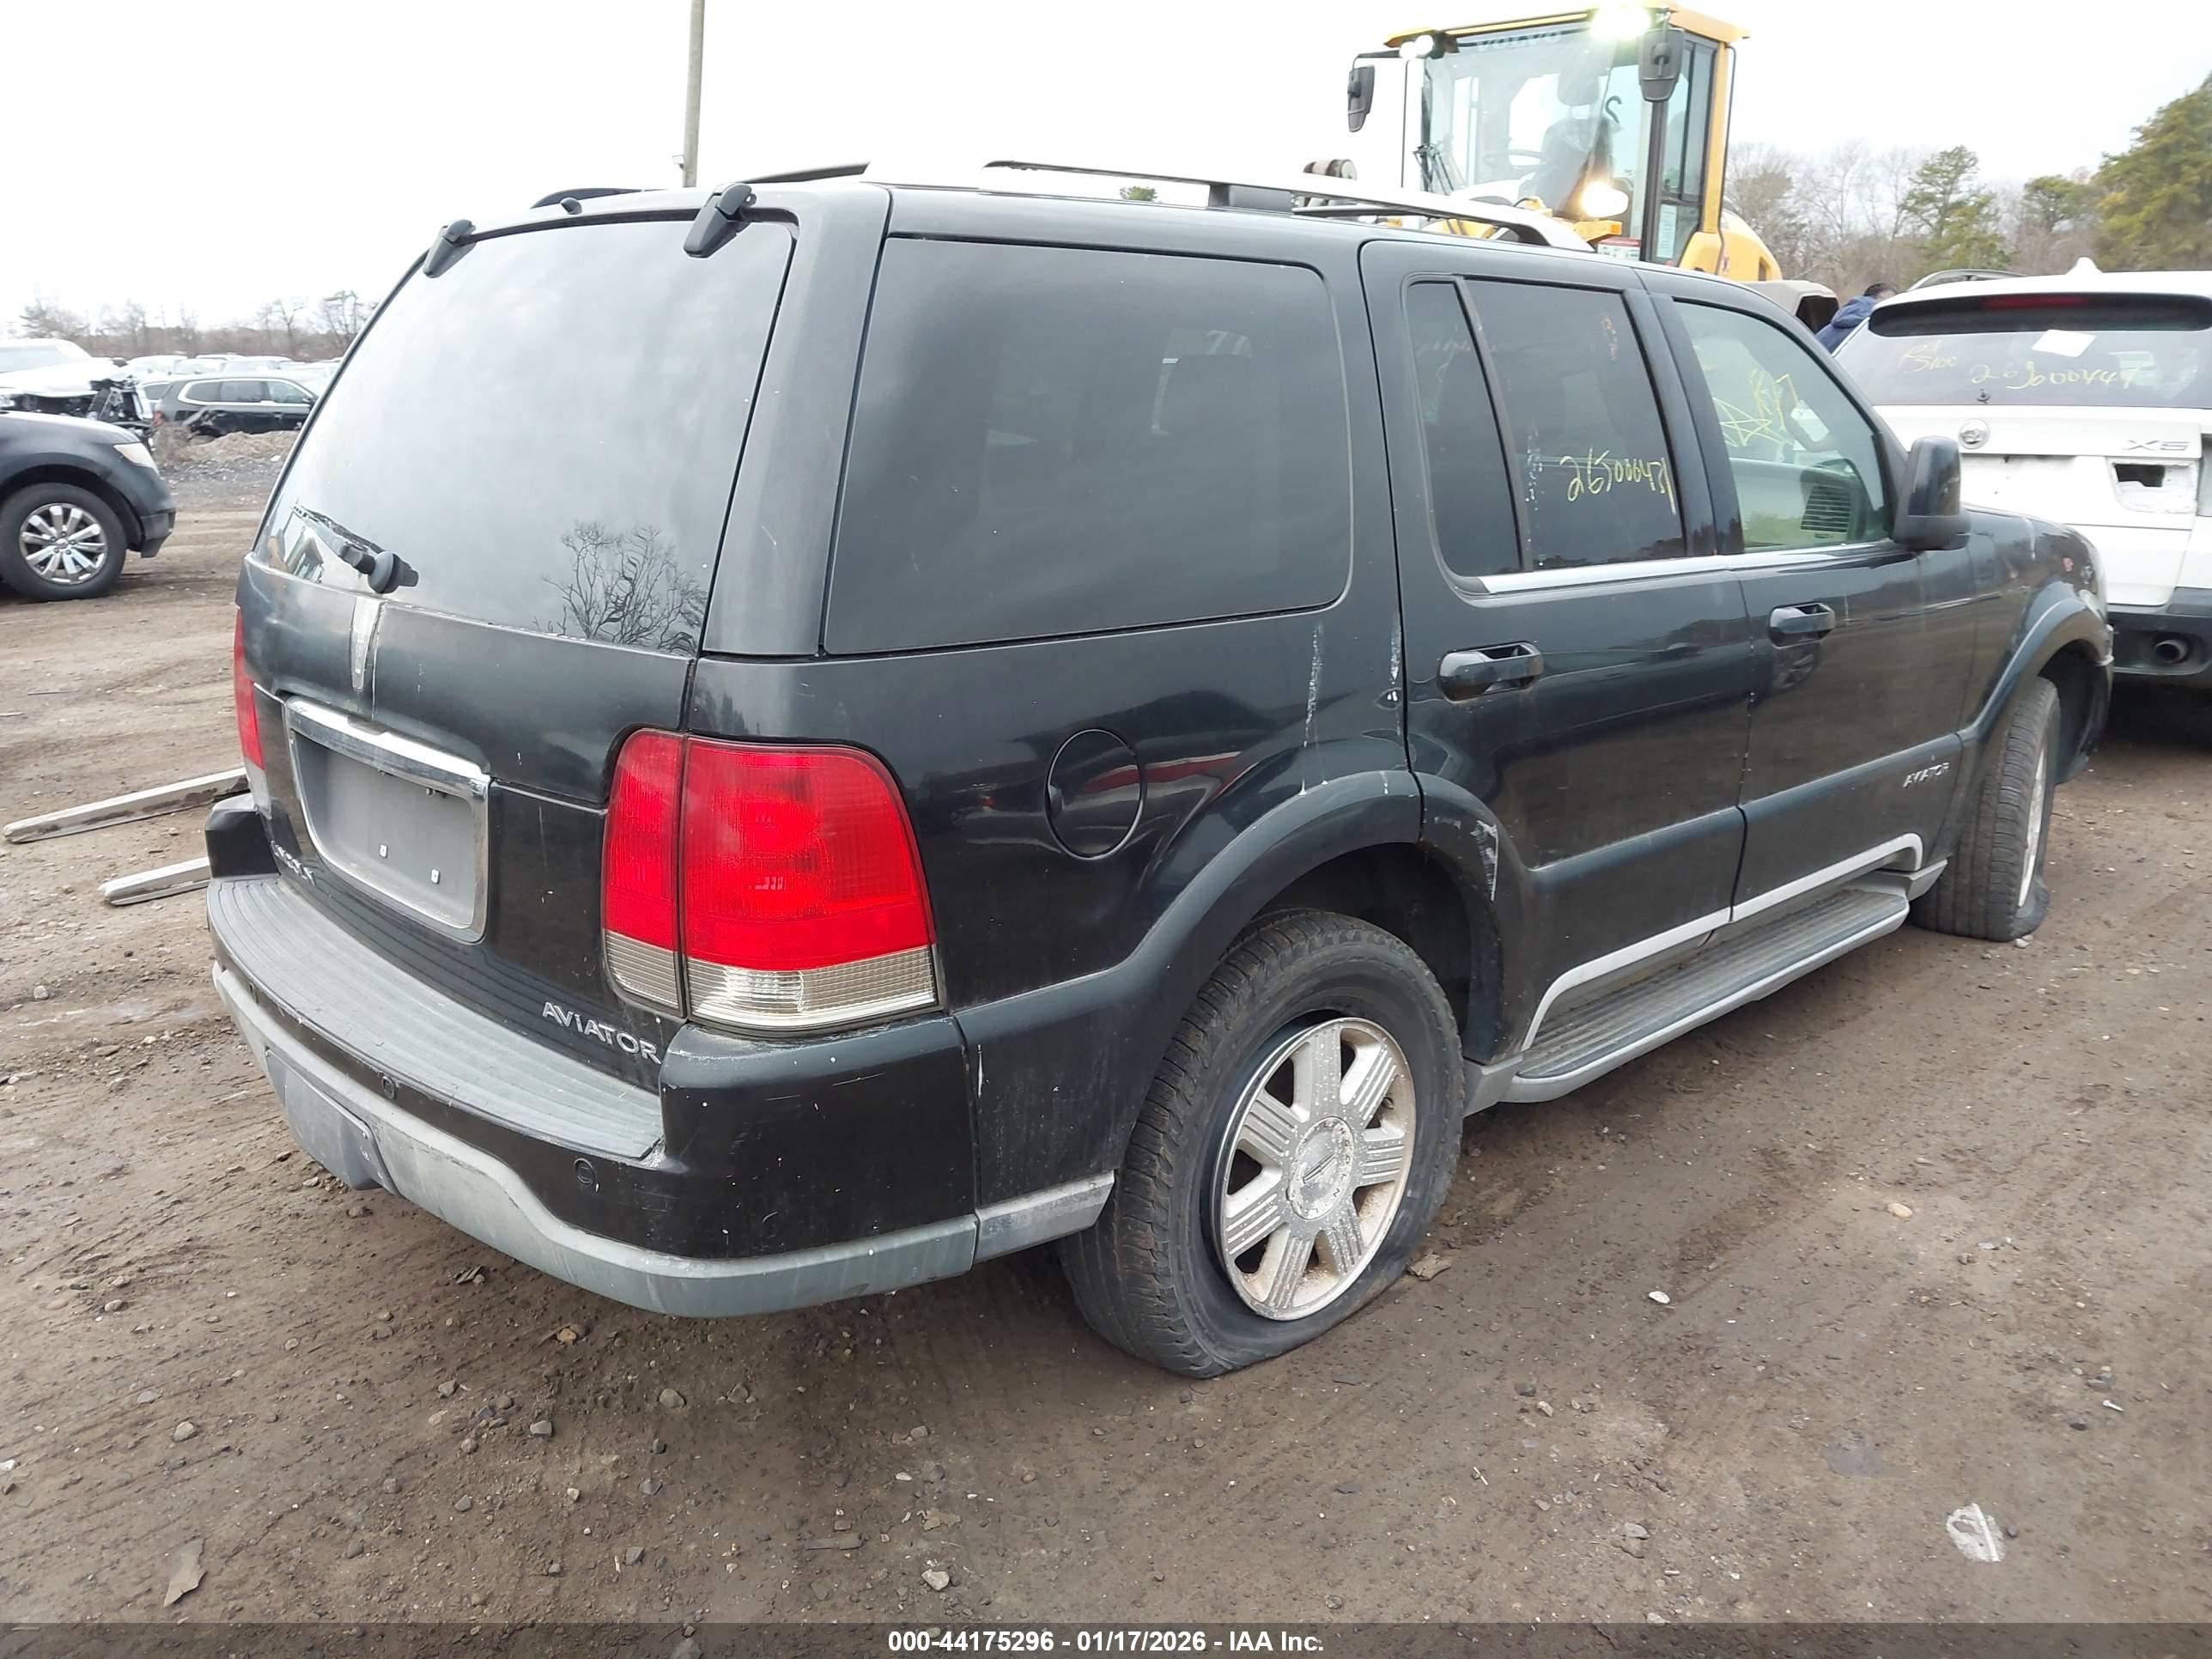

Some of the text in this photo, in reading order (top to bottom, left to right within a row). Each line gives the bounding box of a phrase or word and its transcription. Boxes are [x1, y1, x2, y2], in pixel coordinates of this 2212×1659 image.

[1476, 32, 1561, 52] VOLVO
[2124, 439, 2191, 452] X5
[542, 1001, 662, 1065] AVIATOR
